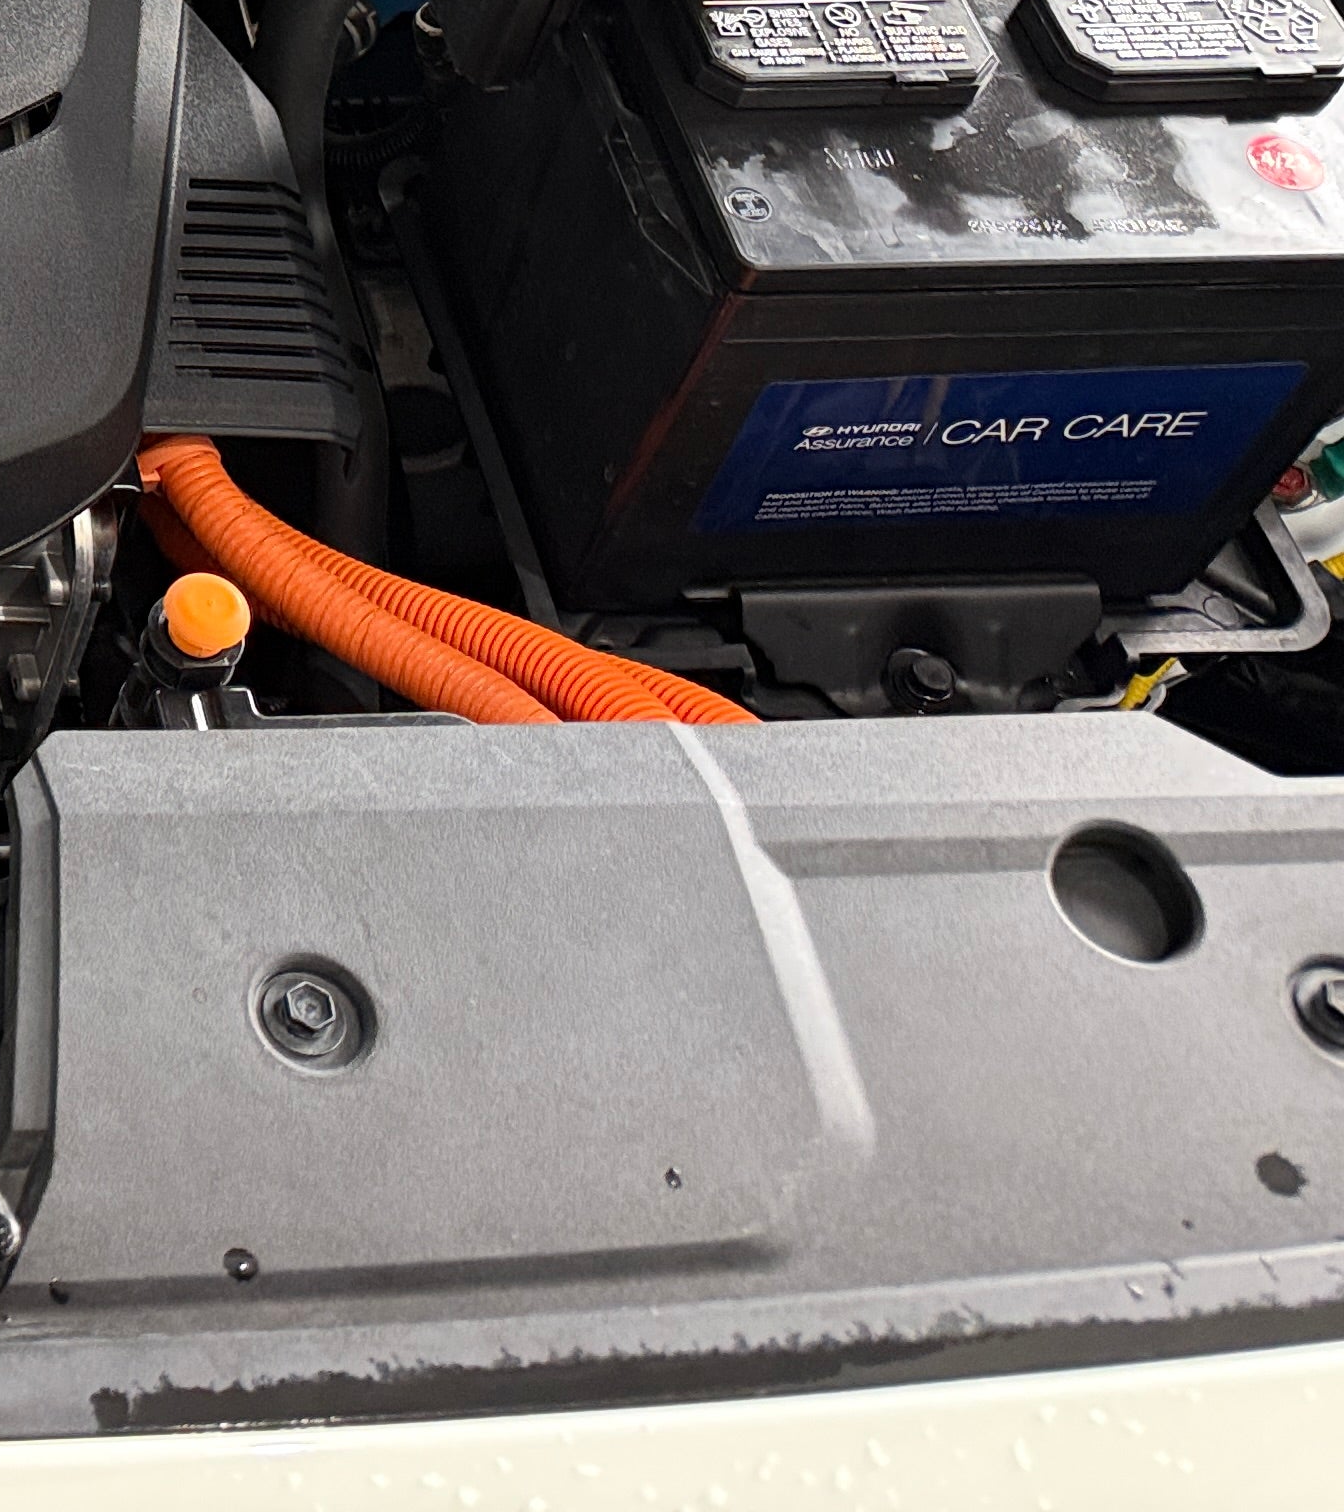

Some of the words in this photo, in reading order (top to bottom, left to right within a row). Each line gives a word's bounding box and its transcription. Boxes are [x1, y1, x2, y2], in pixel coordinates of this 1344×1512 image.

[767, 8, 809, 18] SHIELD
[772, 18, 803, 27] EYES
[750, 27, 811, 37] EXPLOSIVE
[839, 27, 860, 38] NO
[883, 26, 938, 36] SULFURIC
[941, 25, 968, 35] ACID
[755, 37, 793, 48] GASES
[793, 436, 915, 451] Assurance
[941, 418, 1050, 446] CAR
[1062, 411, 1209, 440] CARE
[837, 423, 921, 436] HYUNDAI
